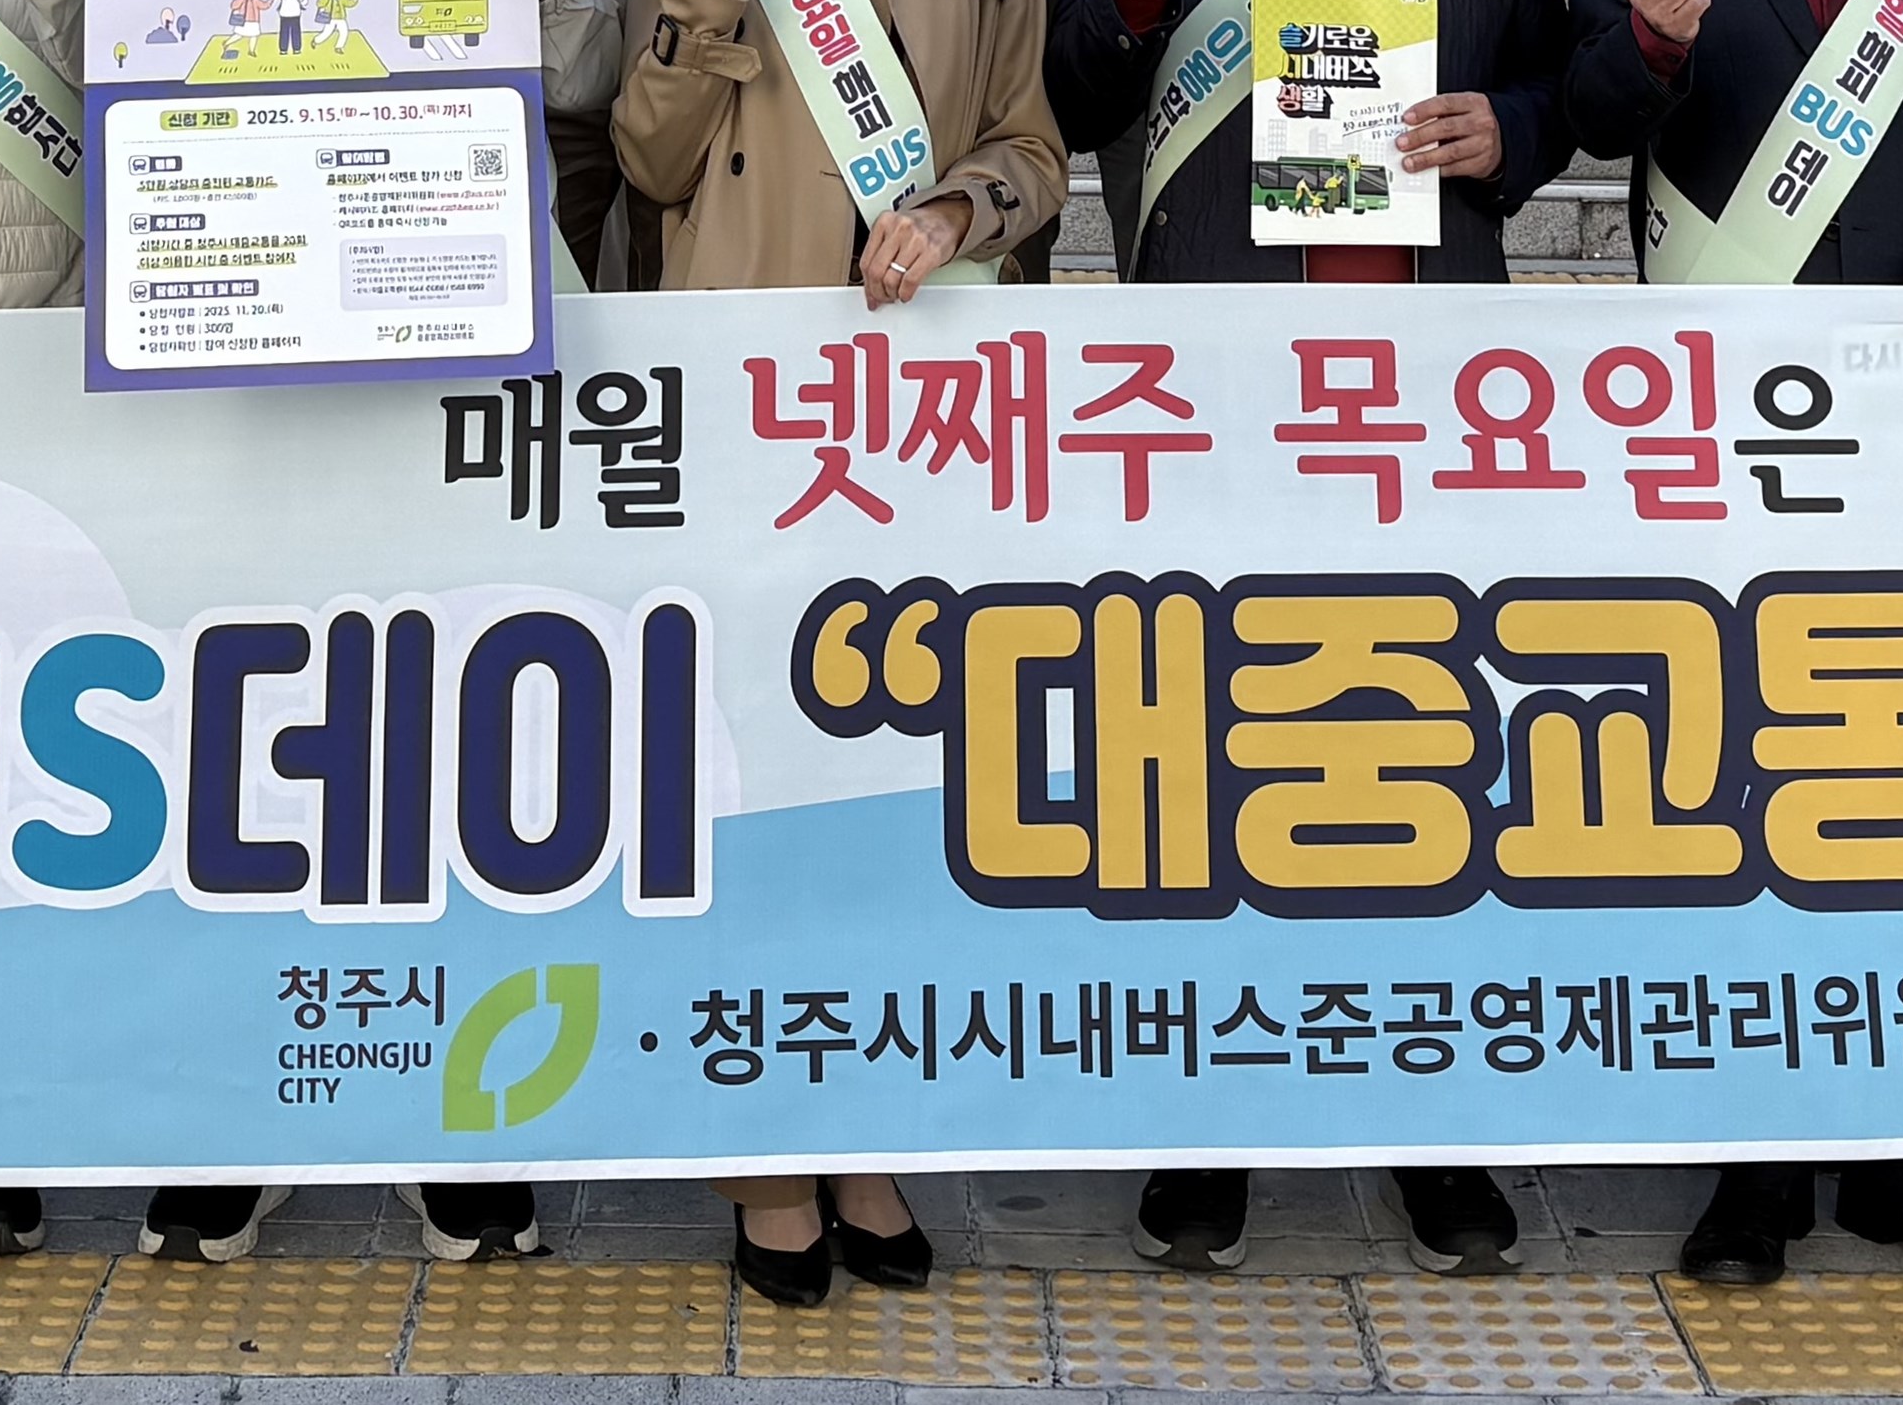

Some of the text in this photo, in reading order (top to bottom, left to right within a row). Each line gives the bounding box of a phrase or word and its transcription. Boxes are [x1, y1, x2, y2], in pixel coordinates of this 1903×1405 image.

[1279, 23, 1372, 50] 슬기로운
[1279, 54, 1374, 80] 시내버스
[1835, 29, 1897, 104] 해피
[247, 108, 294, 125] 2025.
[442, 102, 473, 118] 까지
[832, 62, 892, 141] 해피
[1277, 84, 1327, 112] 생활
[1789, 82, 1874, 157] BUS
[848, 127, 927, 200] BUS
[1767, 140, 1829, 217] 데이
[444, 329, 1861, 529] 매월 넷째주 목요일은
[278, 966, 444, 1030] 청주시
[278, 1078, 341, 1104] CITY
[279, 1043, 431, 1075] CHEONGJU
